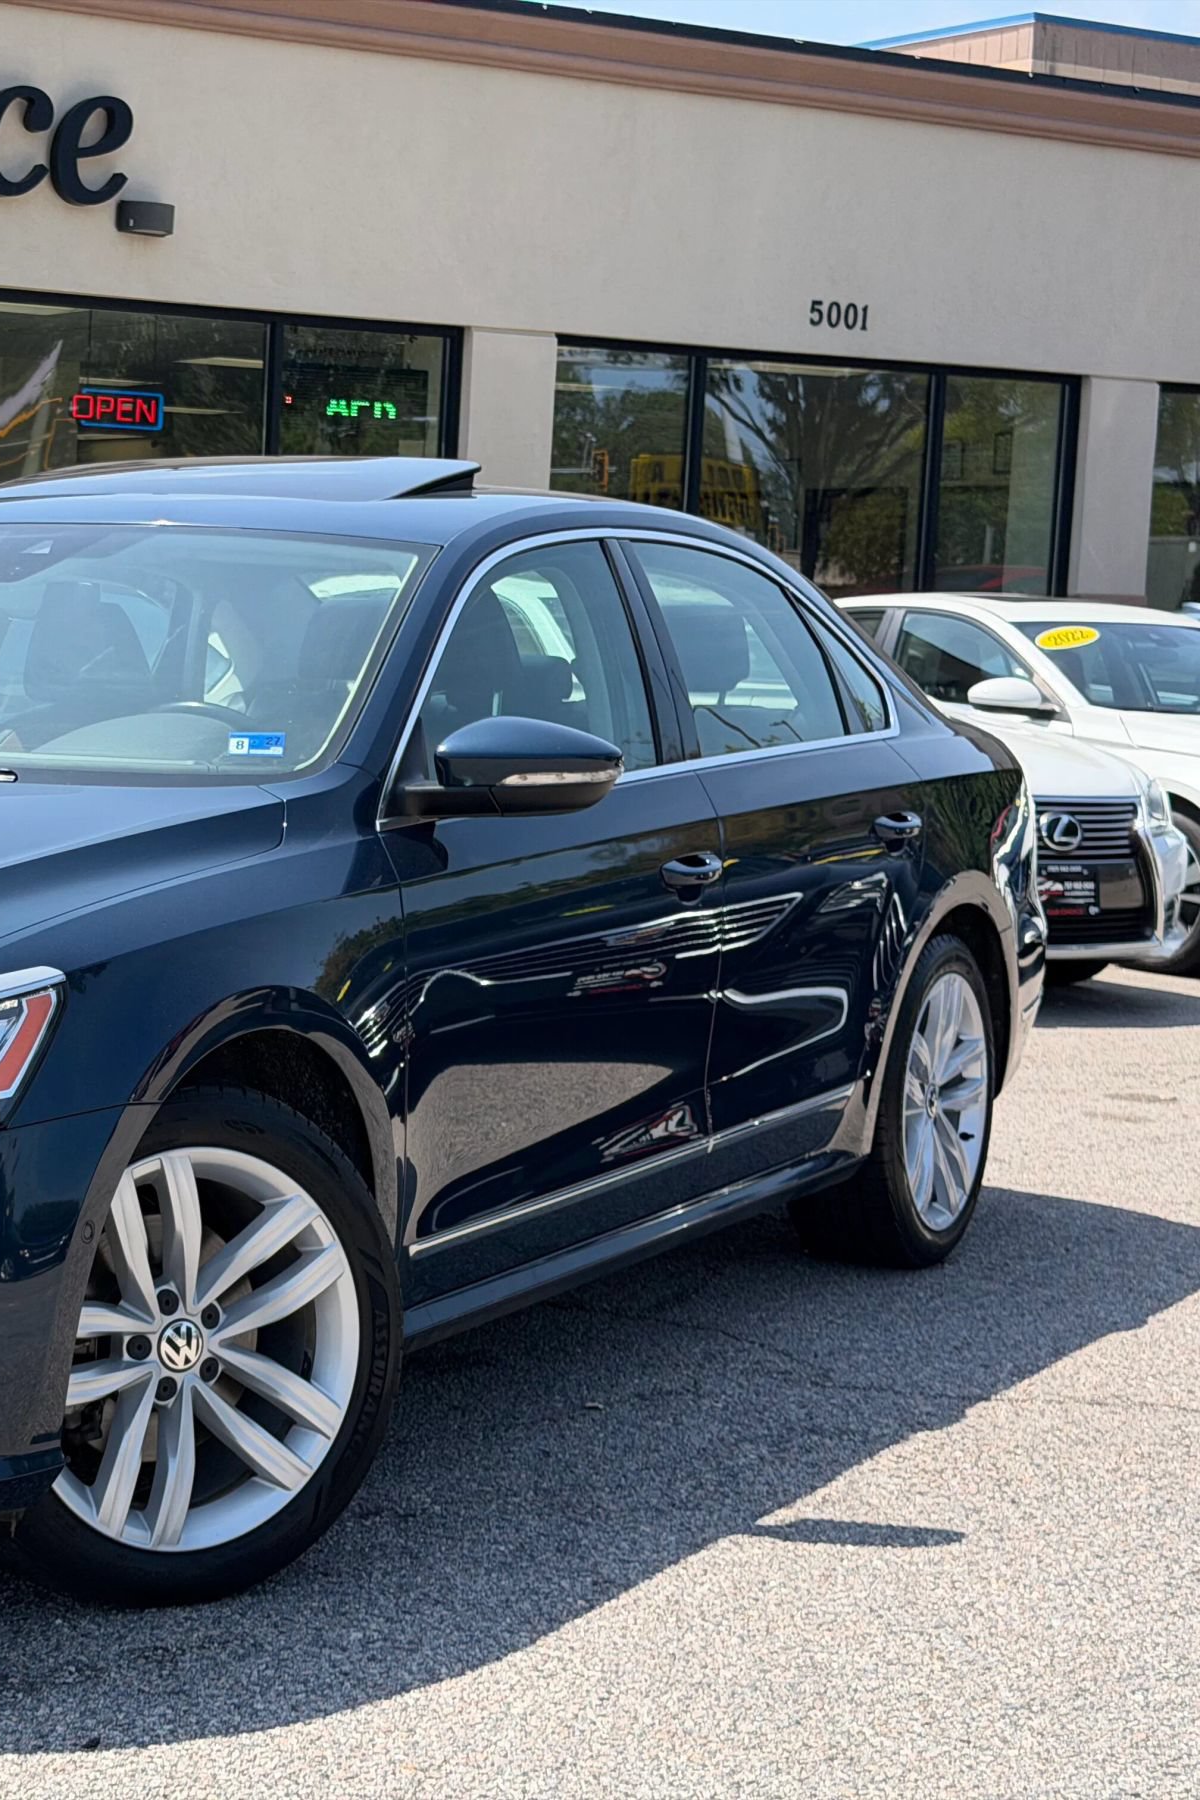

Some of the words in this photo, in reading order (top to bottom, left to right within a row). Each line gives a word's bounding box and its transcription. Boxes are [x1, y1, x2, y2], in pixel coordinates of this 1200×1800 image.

[809, 300, 869, 331] 5001
[72, 394, 157, 424] OPEN
[235, 740, 245, 750] 8
